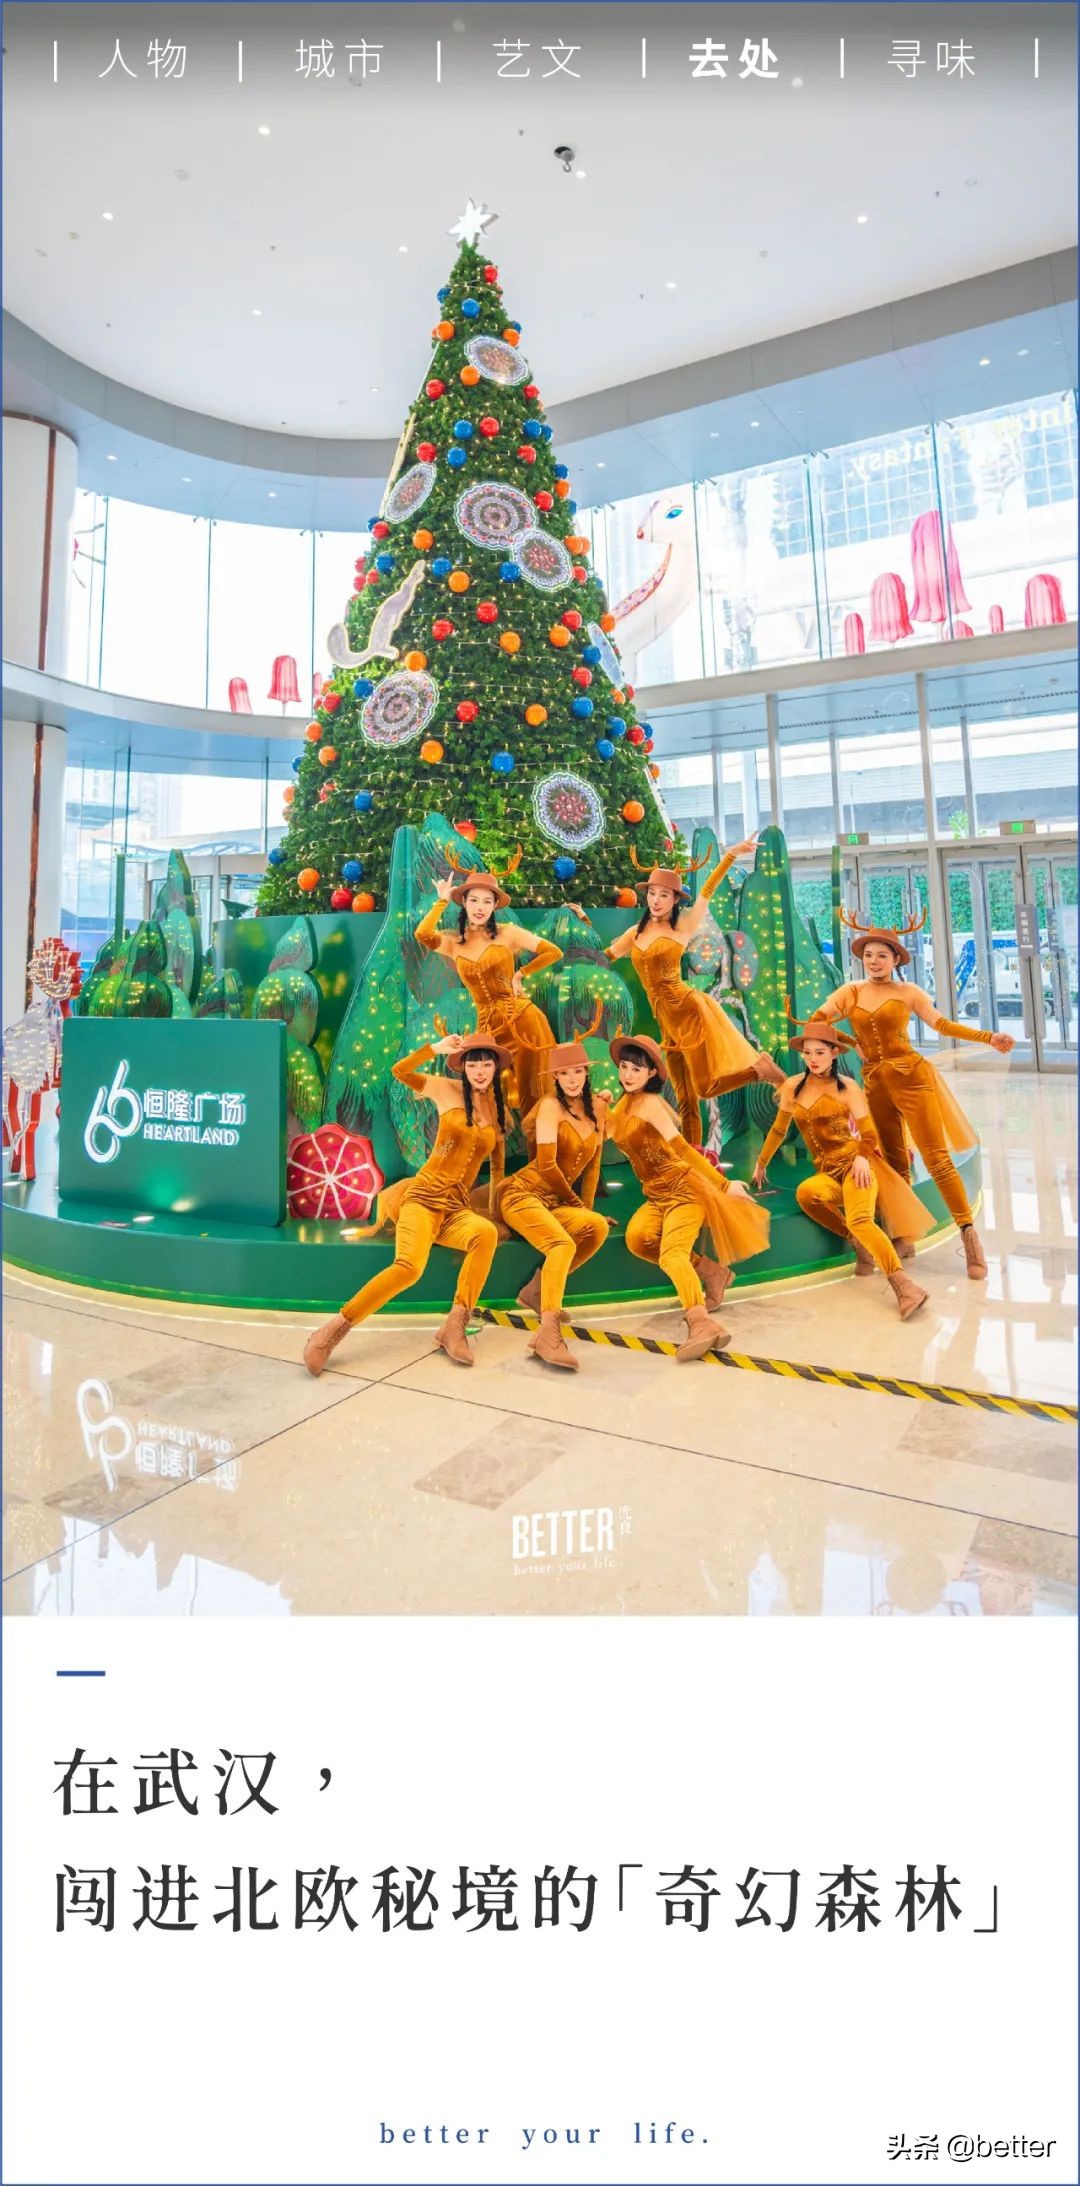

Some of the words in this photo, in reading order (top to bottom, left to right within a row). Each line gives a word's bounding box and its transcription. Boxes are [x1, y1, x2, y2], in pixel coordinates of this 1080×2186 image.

[143, 1088, 246, 1125] 恒隆广场
[143, 1123, 239, 1146] HEARTLAND
